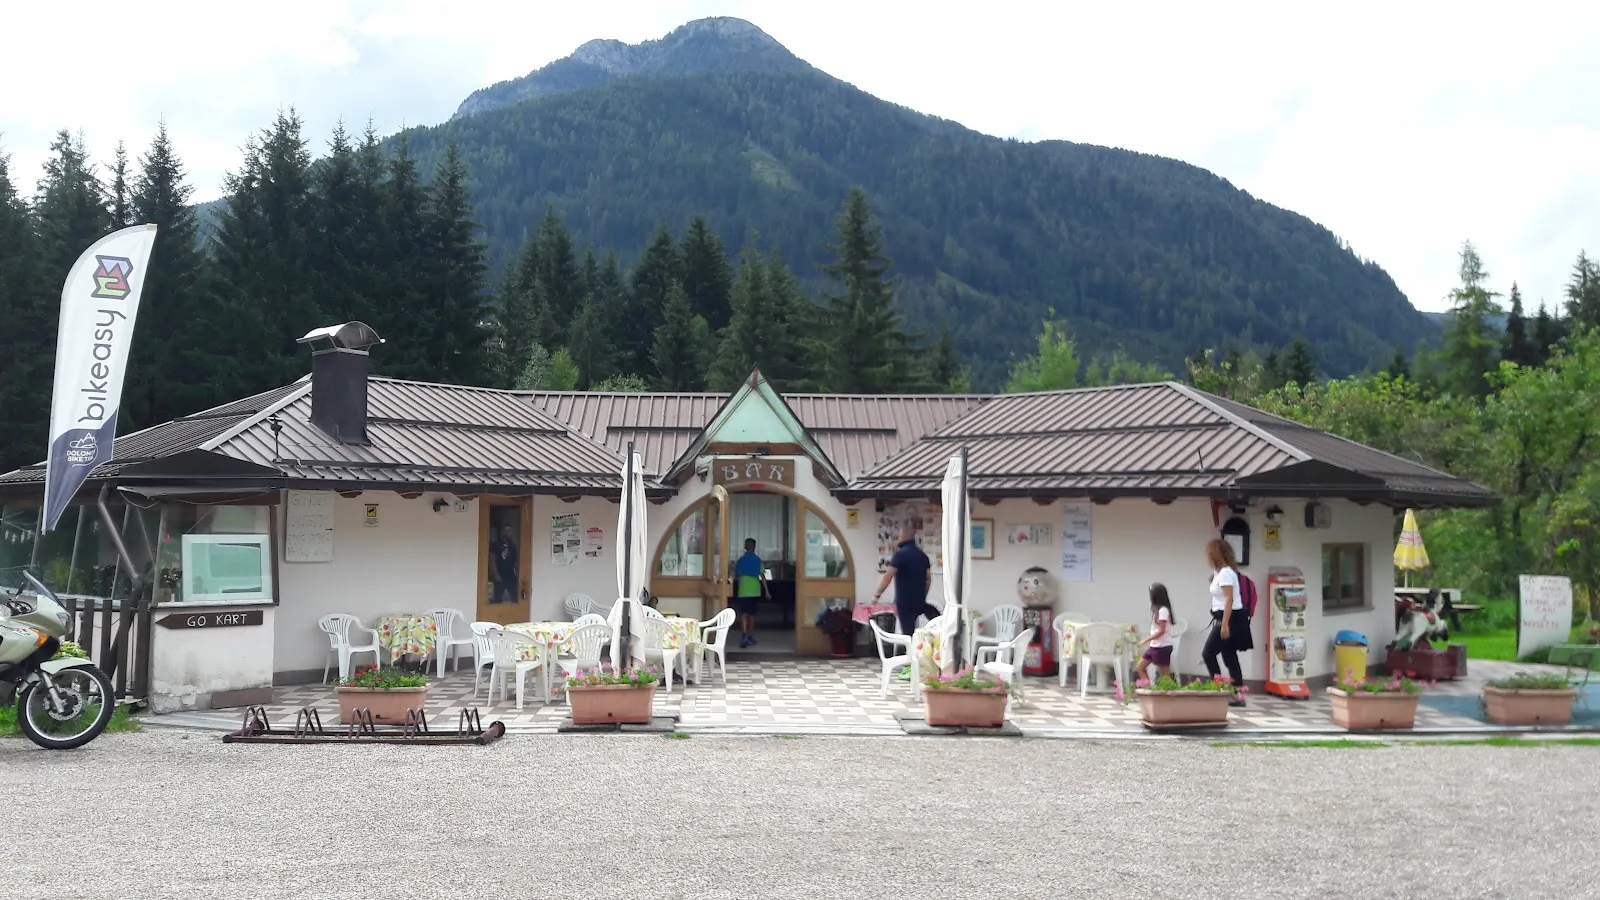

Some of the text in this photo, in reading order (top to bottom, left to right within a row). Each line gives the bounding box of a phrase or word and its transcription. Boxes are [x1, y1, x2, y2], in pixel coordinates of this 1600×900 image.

[78, 309, 127, 423] bikeasy
[721, 462, 785, 482] BAR
[186, 614, 248, 627] GO KART
